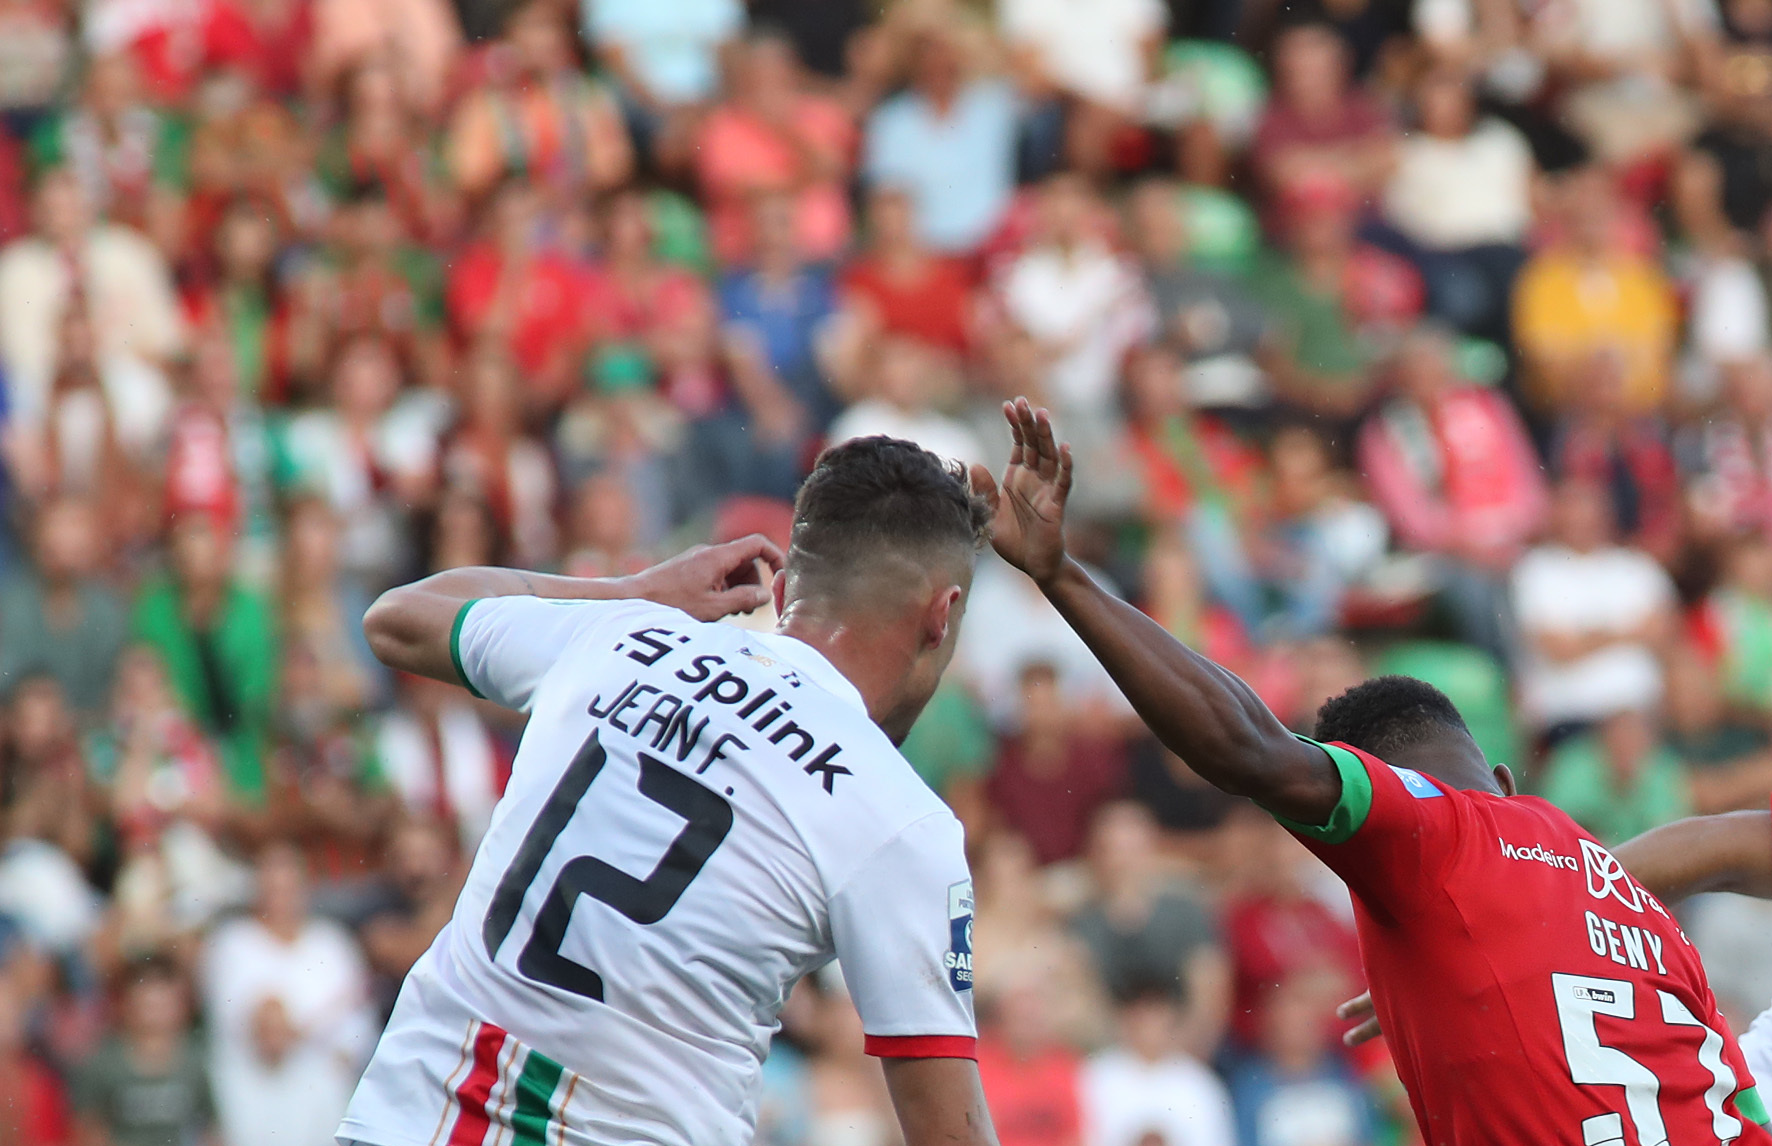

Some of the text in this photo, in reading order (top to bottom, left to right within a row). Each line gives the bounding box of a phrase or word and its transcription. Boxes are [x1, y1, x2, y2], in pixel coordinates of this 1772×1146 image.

[587, 678, 751, 797] JEAN F.
[674, 654, 854, 796] Splink
[482, 726, 734, 1004] 12
[1498, 836, 1579, 872] Madeira
[1583, 910, 1668, 976] GENY
[1591, 990, 1614, 1003] bwin
